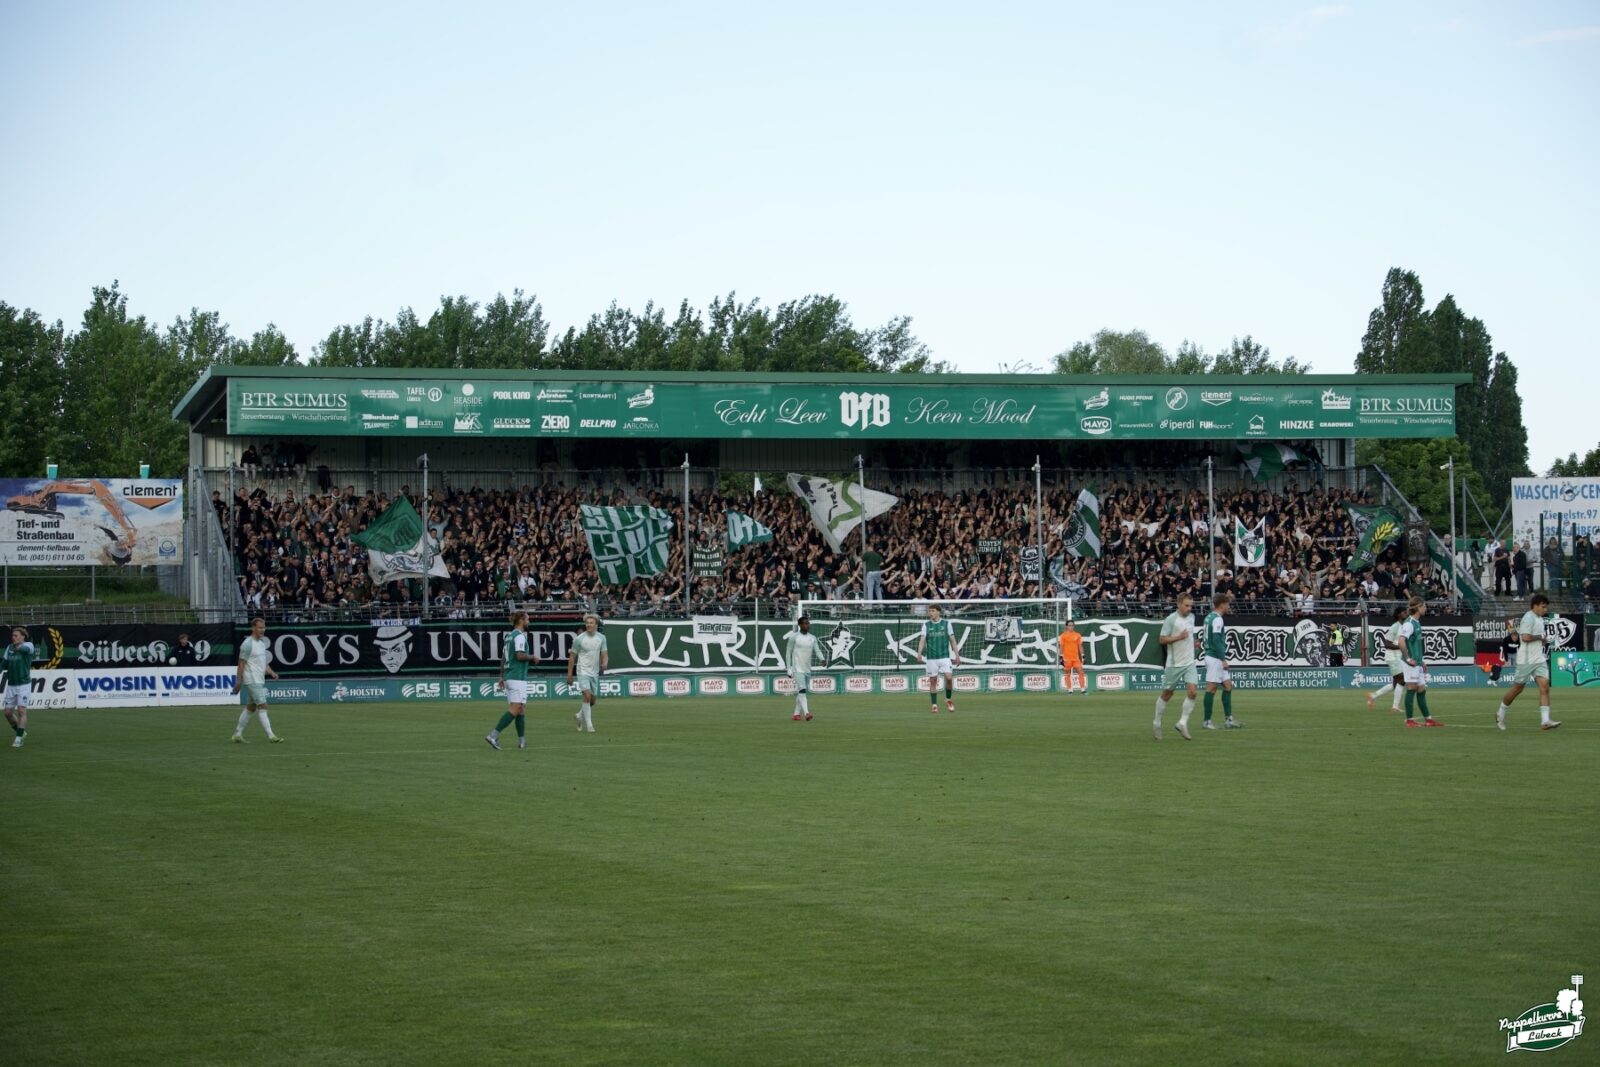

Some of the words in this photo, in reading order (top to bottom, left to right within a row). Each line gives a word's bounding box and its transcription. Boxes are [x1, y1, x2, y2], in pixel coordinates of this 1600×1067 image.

[407, 387, 425, 395] TAFEL
[1200, 391, 1232, 399] clement
[241, 392, 277, 407] BTR
[283, 393, 347, 407] SUMUS
[454, 396, 483, 404] SEASIDE
[1360, 398, 1392, 412] BTR
[1397, 398, 1453, 412] SUMUS
[714, 399, 767, 425] Echt
[775, 397, 829, 425] Leev
[905, 396, 964, 425] Keen
[969, 398, 1037, 425] Mood
[580, 419, 617, 428] DELLPRO
[1084, 420, 1109, 428] MAYO
[1169, 420, 1194, 431] iperdi
[1280, 420, 1314, 430] HINZKE
[123, 484, 178, 497] clement
[1514, 485, 1558, 500] WASCH
[1543, 509, 1598, 520] Zieelstr.97
[17, 520, 40, 529] Tief-
[41, 520, 60, 529] und
[16, 530, 75, 541] Straßenbau
[1248, 670, 1338, 679] IMMOBILIENEXPERTEN
[1434, 675, 1466, 683] HOLSTEN
[78, 676, 157, 692] WOISIN
[161, 675, 237, 690] WOISIN
[1238, 680, 1251, 688] DER
[1251, 678, 1294, 688] LÜBECKER
[1295, 679, 1329, 687] BUCHT.
[350, 688, 385, 696] HOLSTEN
[416, 683, 441, 693] FLS
[449, 684, 472, 695] 30
[600, 682, 621, 694] 30
[271, 689, 307, 698] HOLSTEN
